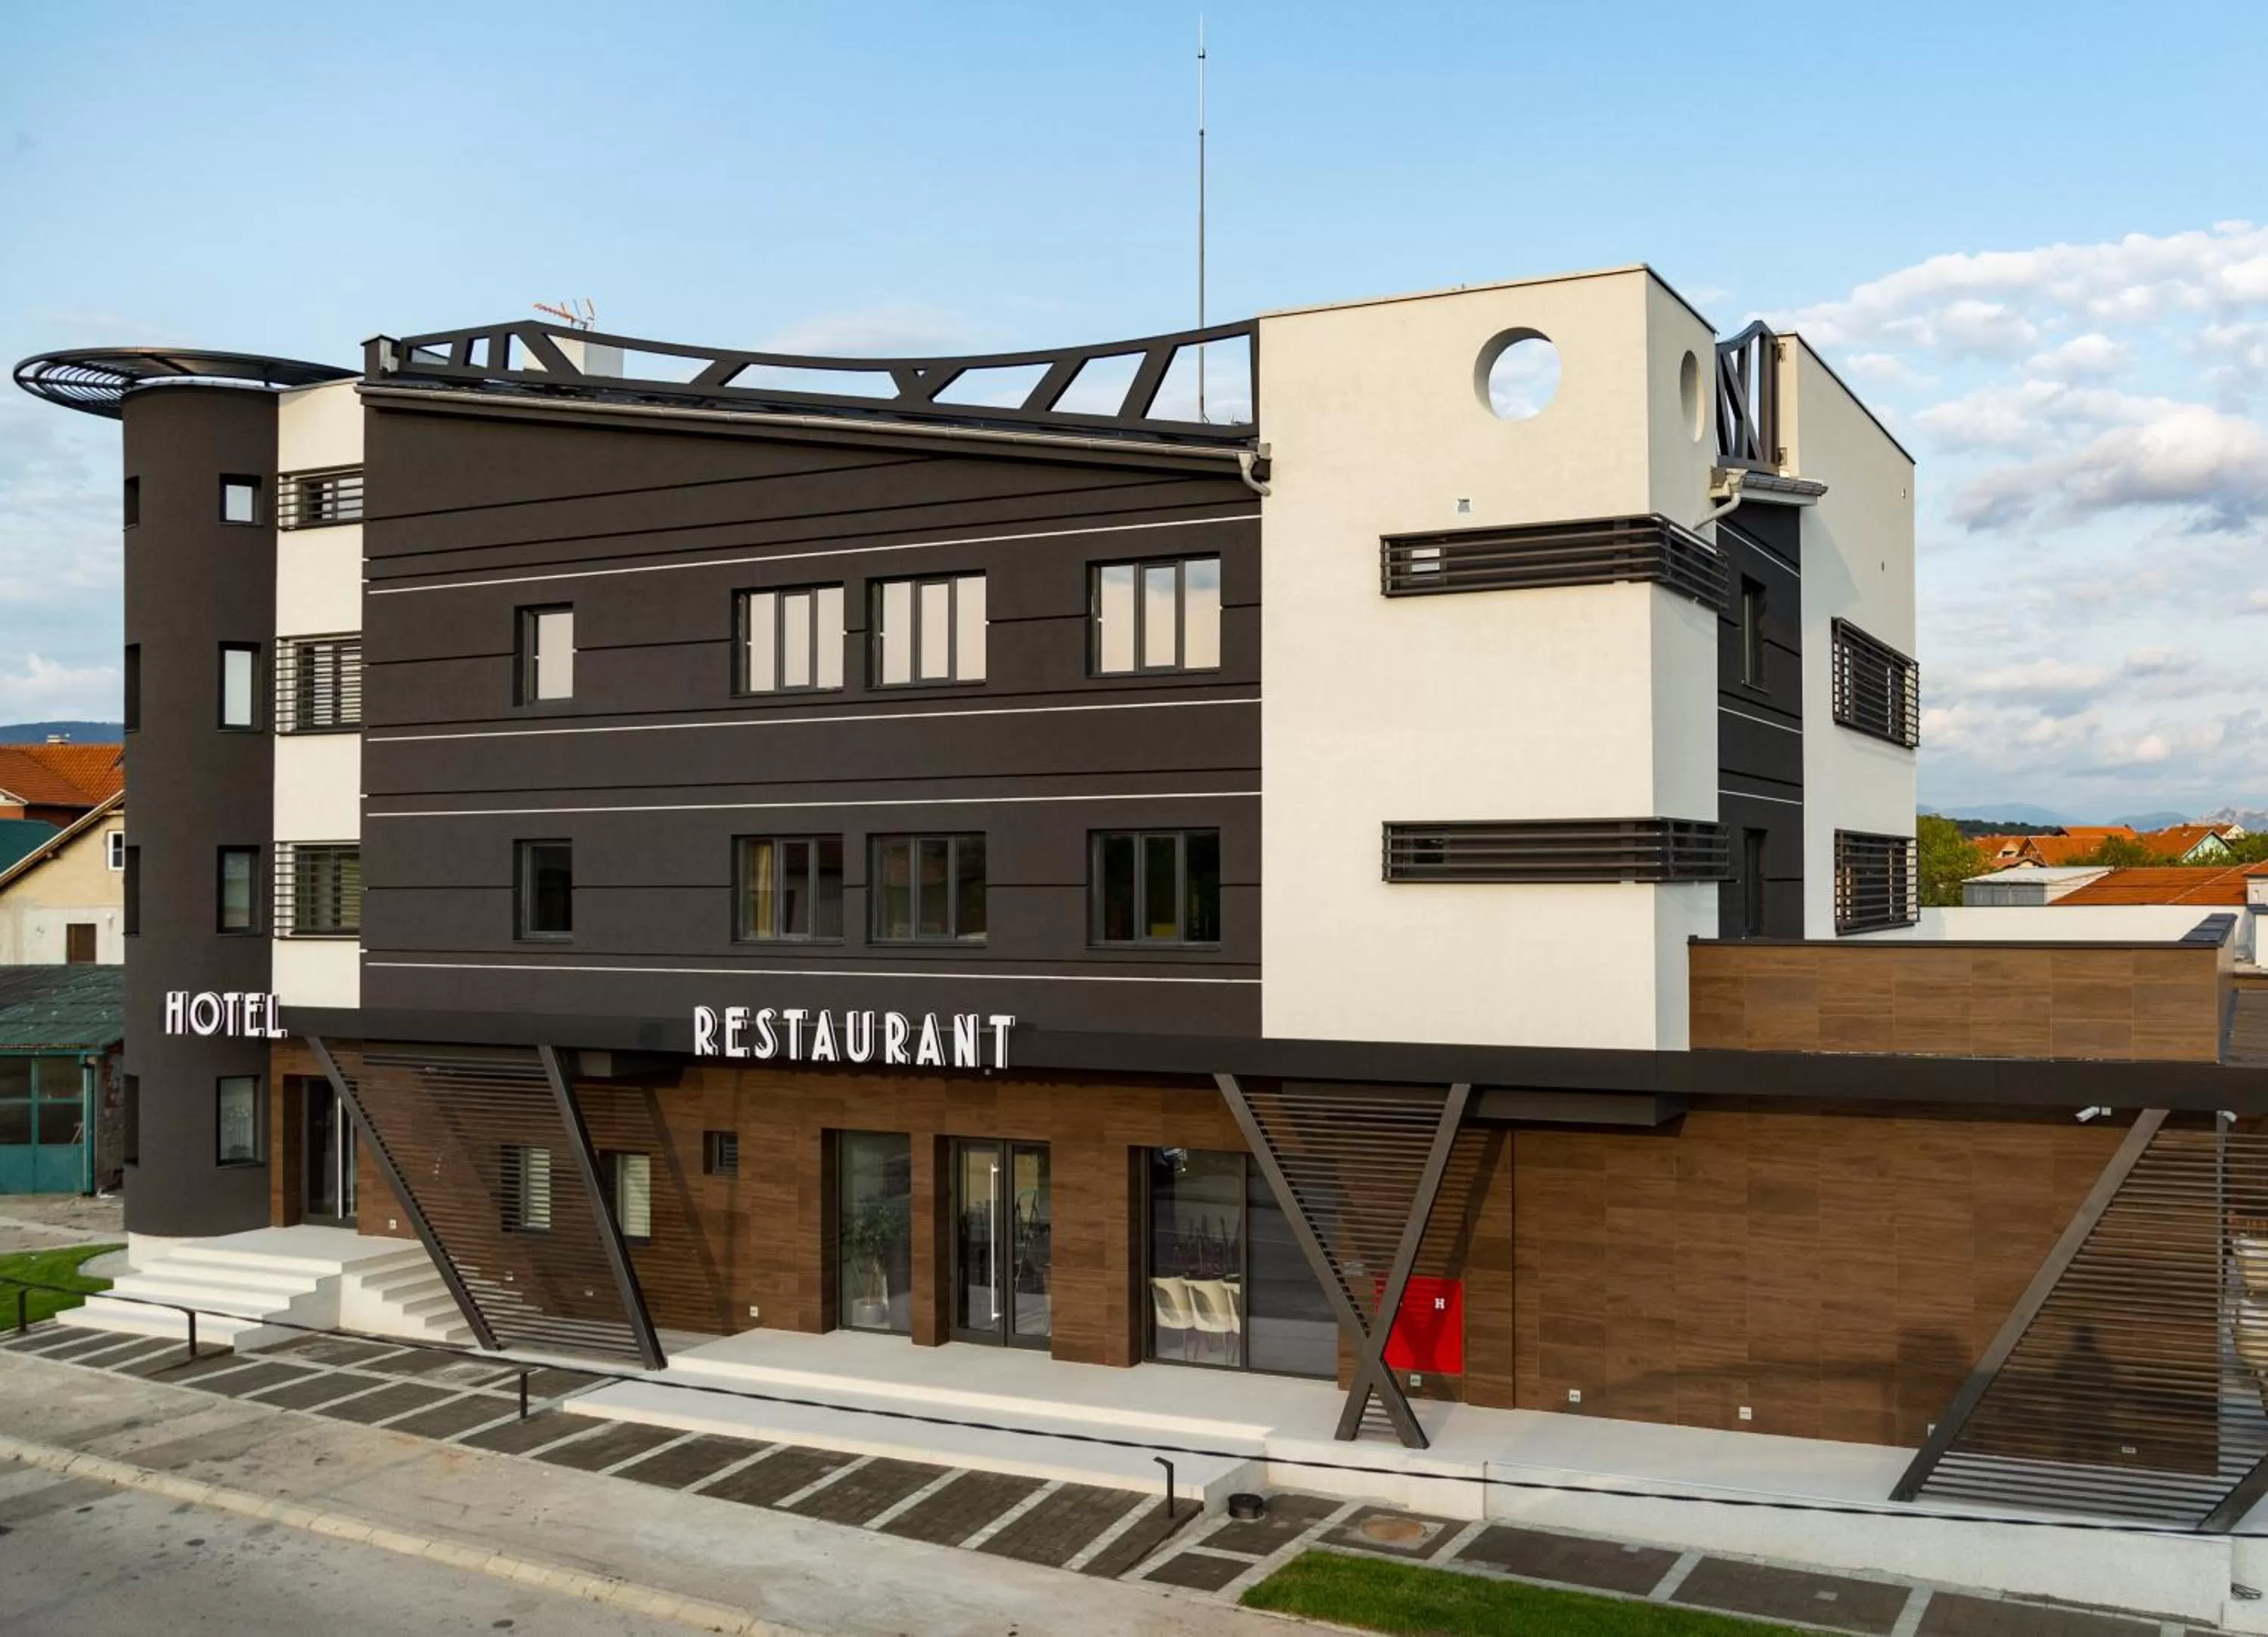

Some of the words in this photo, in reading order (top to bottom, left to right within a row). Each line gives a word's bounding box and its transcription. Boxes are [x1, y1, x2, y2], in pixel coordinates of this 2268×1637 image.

[166, 991, 288, 1038] HOTEL
[693, 1006, 1015, 1069] RESTAURANT
[1434, 1298, 1445, 1310] H
